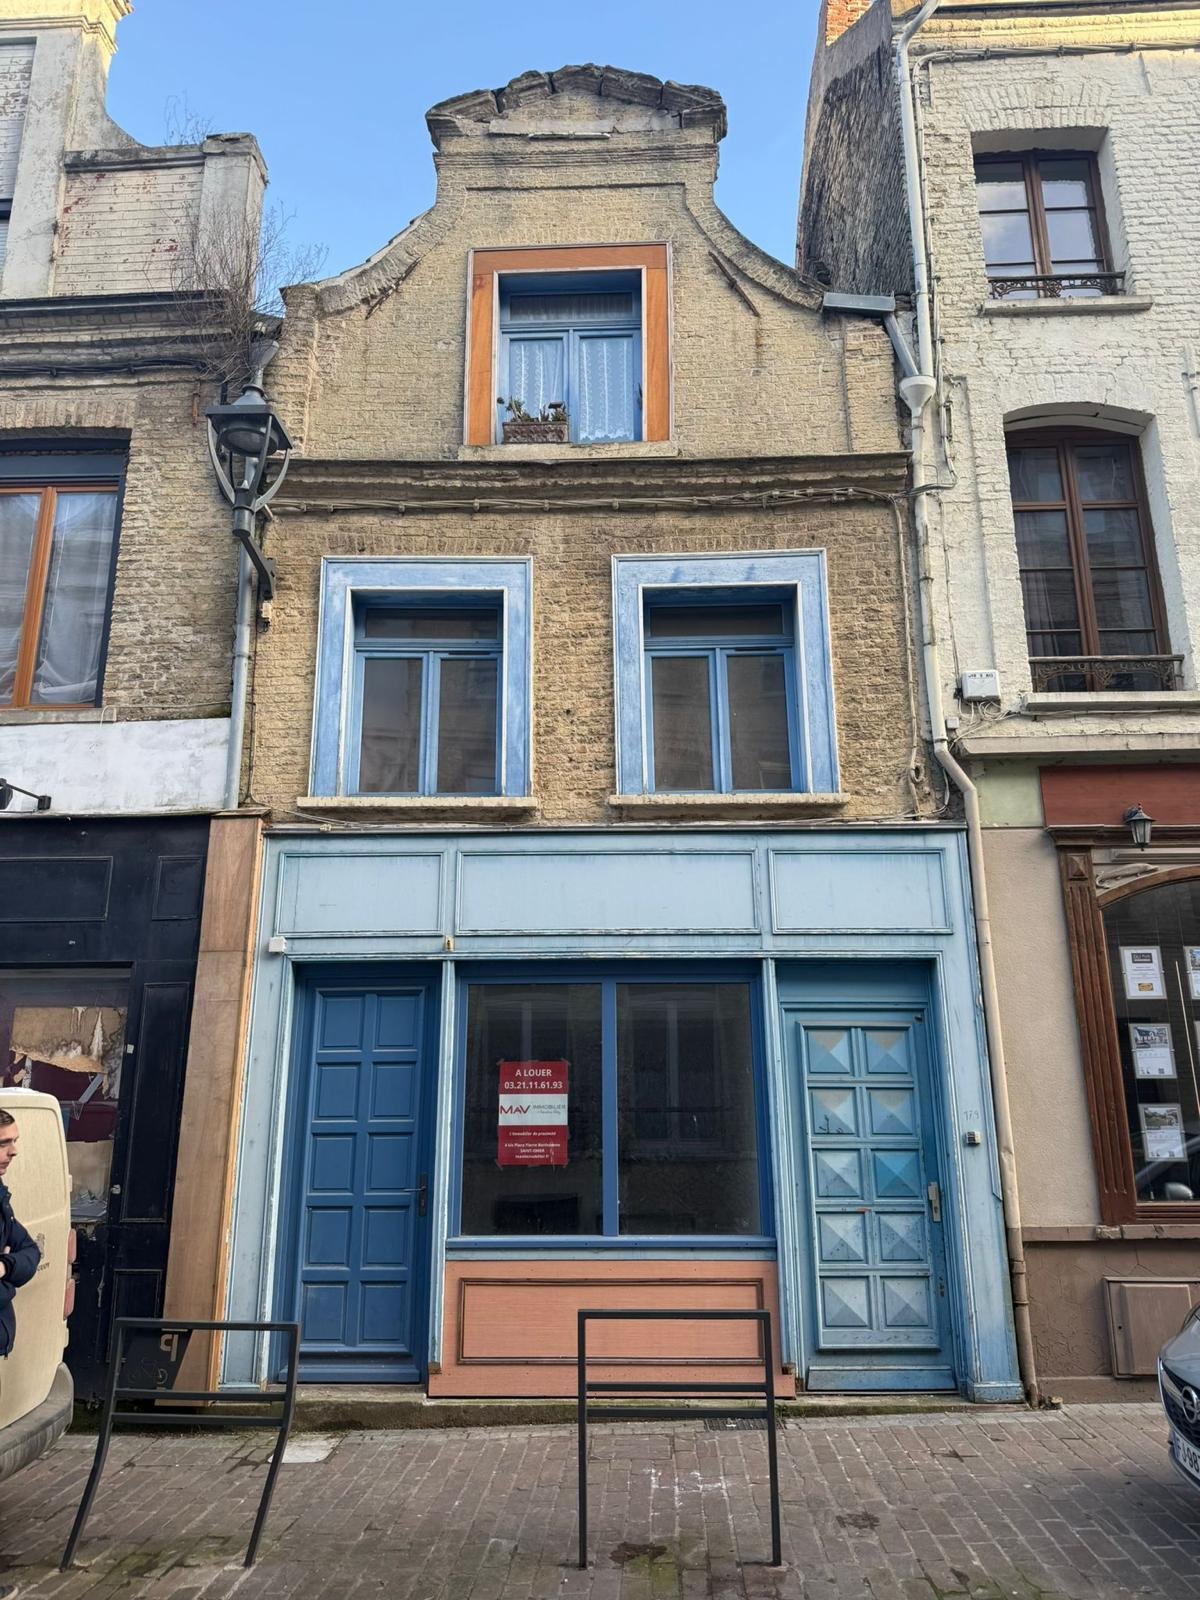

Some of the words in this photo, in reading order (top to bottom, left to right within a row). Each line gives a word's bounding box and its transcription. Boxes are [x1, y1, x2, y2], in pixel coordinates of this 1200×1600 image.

[515, 1068, 522, 1077] A
[523, 1068, 552, 1077] LOUER
[504, 1081, 563, 1089] 03.21.11.61.93
[499, 1104, 531, 1114] MAV
